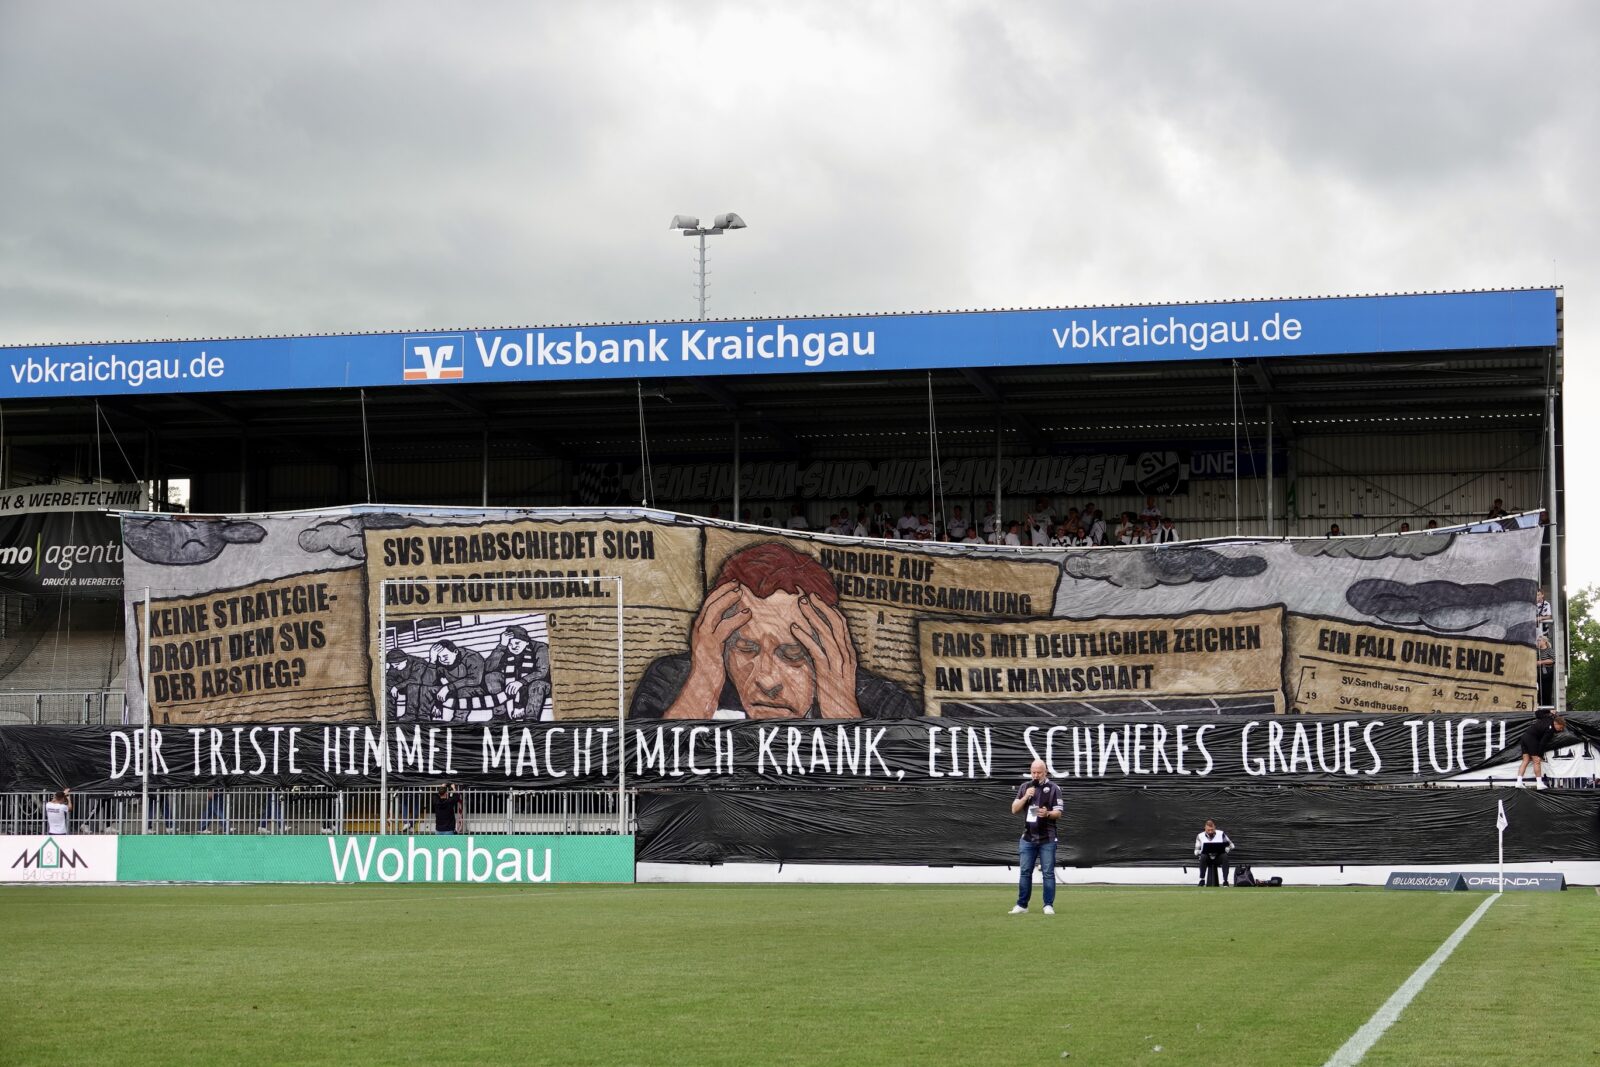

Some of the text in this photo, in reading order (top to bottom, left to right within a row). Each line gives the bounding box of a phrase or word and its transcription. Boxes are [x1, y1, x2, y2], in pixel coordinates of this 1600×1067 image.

[476, 325, 877, 368] Volksbank Kraichgau
[1052, 312, 1303, 351] vbkraichgau.de
[10, 352, 225, 386] vbkraichgau.de
[629, 462, 800, 500] GEMEINSAM
[802, 459, 873, 499] SIND
[876, 459, 934, 497] WIR
[935, 454, 1128, 496] SANDHAUSEN
[14, 495, 25, 508] &
[29, 491, 143, 508] WERBETECHNIK
[383, 530, 655, 567] SVS VERABSCHIEDET SICH
[820, 548, 935, 582] UNRUHE AUF
[42, 578, 70, 586] DRUCK
[70, 578, 77, 586] &
[385, 577, 431, 606] AUS
[833, 573, 1032, 615] IEDERVERSAMMLUNG
[150, 583, 338, 638] KEINE STRATEGIE-
[150, 620, 327, 674] DROHT DEM SVS
[932, 625, 1261, 658] FANS MIT DEUTLICHEM ZEICHEN
[1318, 628, 1506, 676] EIN FALL OHNE ENDE
[154, 658, 307, 703] DER ABSTIEG?
[935, 664, 1154, 693] AN DIE MANNSCHAFT
[1342, 676, 1354, 685] SV
[1355, 678, 1411, 693] Sandhausen
[1432, 688, 1443, 698] 14
[1515, 701, 1527, 710] 26
[1340, 696, 1352, 705] SV
[1353, 698, 1409, 713] Sandhausen
[110, 718, 1506, 782] DER TRISTE HIMMEL MACHT MICH KRANK, EIN SCHWERES GRAUES TUCH
[328, 836, 552, 882] Wohnbau
[1468, 877, 1540, 886] ORENDA
